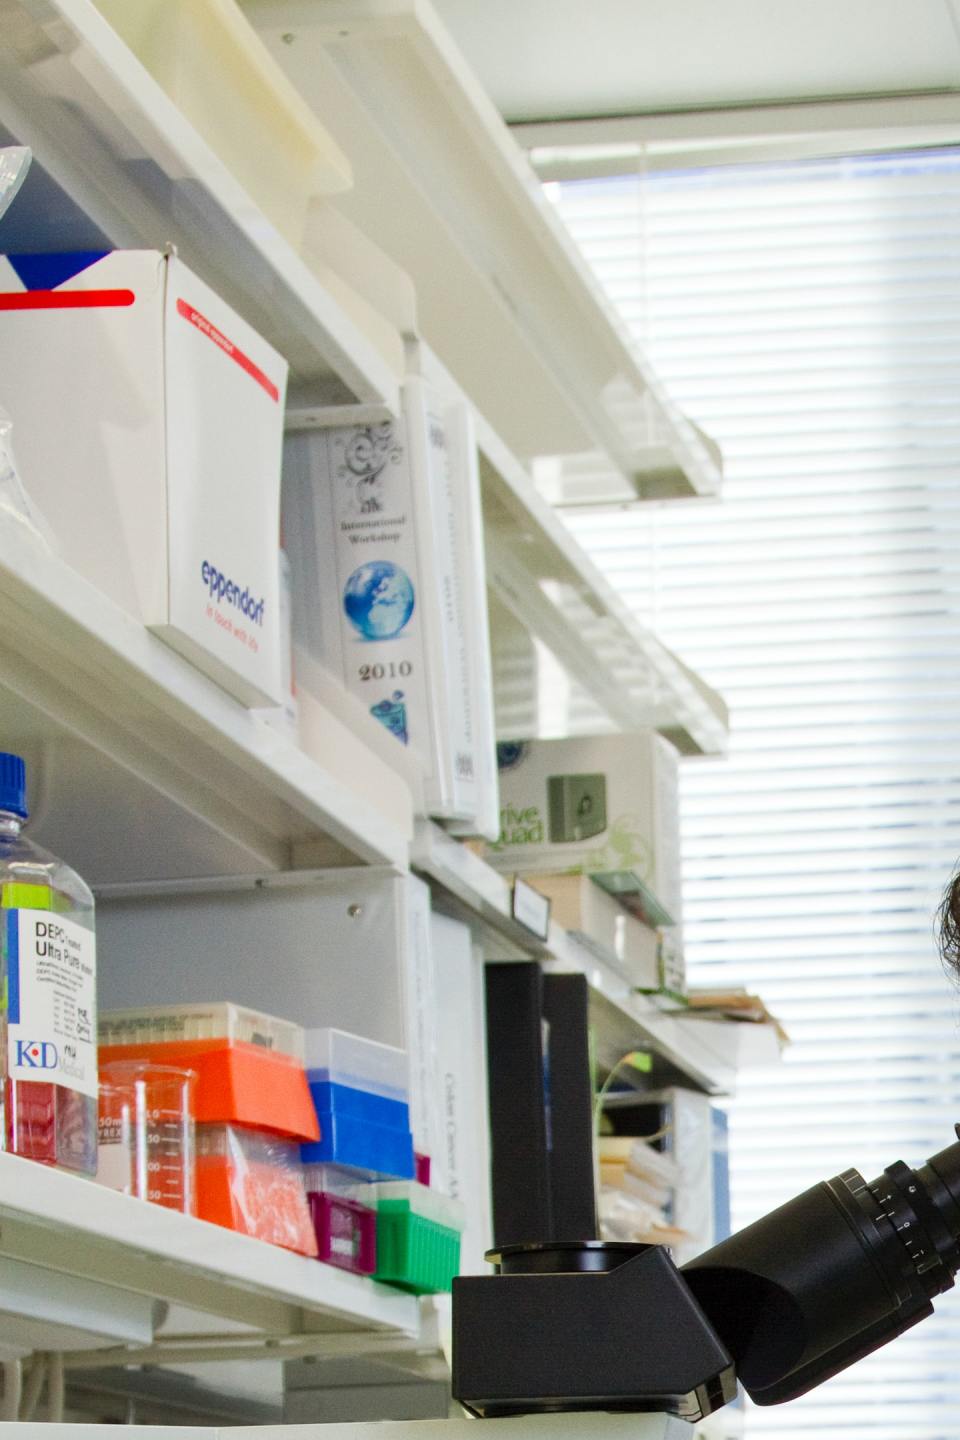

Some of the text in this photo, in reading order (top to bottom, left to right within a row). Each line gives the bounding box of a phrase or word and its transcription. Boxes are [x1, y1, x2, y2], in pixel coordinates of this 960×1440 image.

[201, 560, 264, 627] eppendorf
[358, 661, 412, 681] 2010
[500, 802, 539, 824] rive
[35, 940, 61, 961] Ultra
